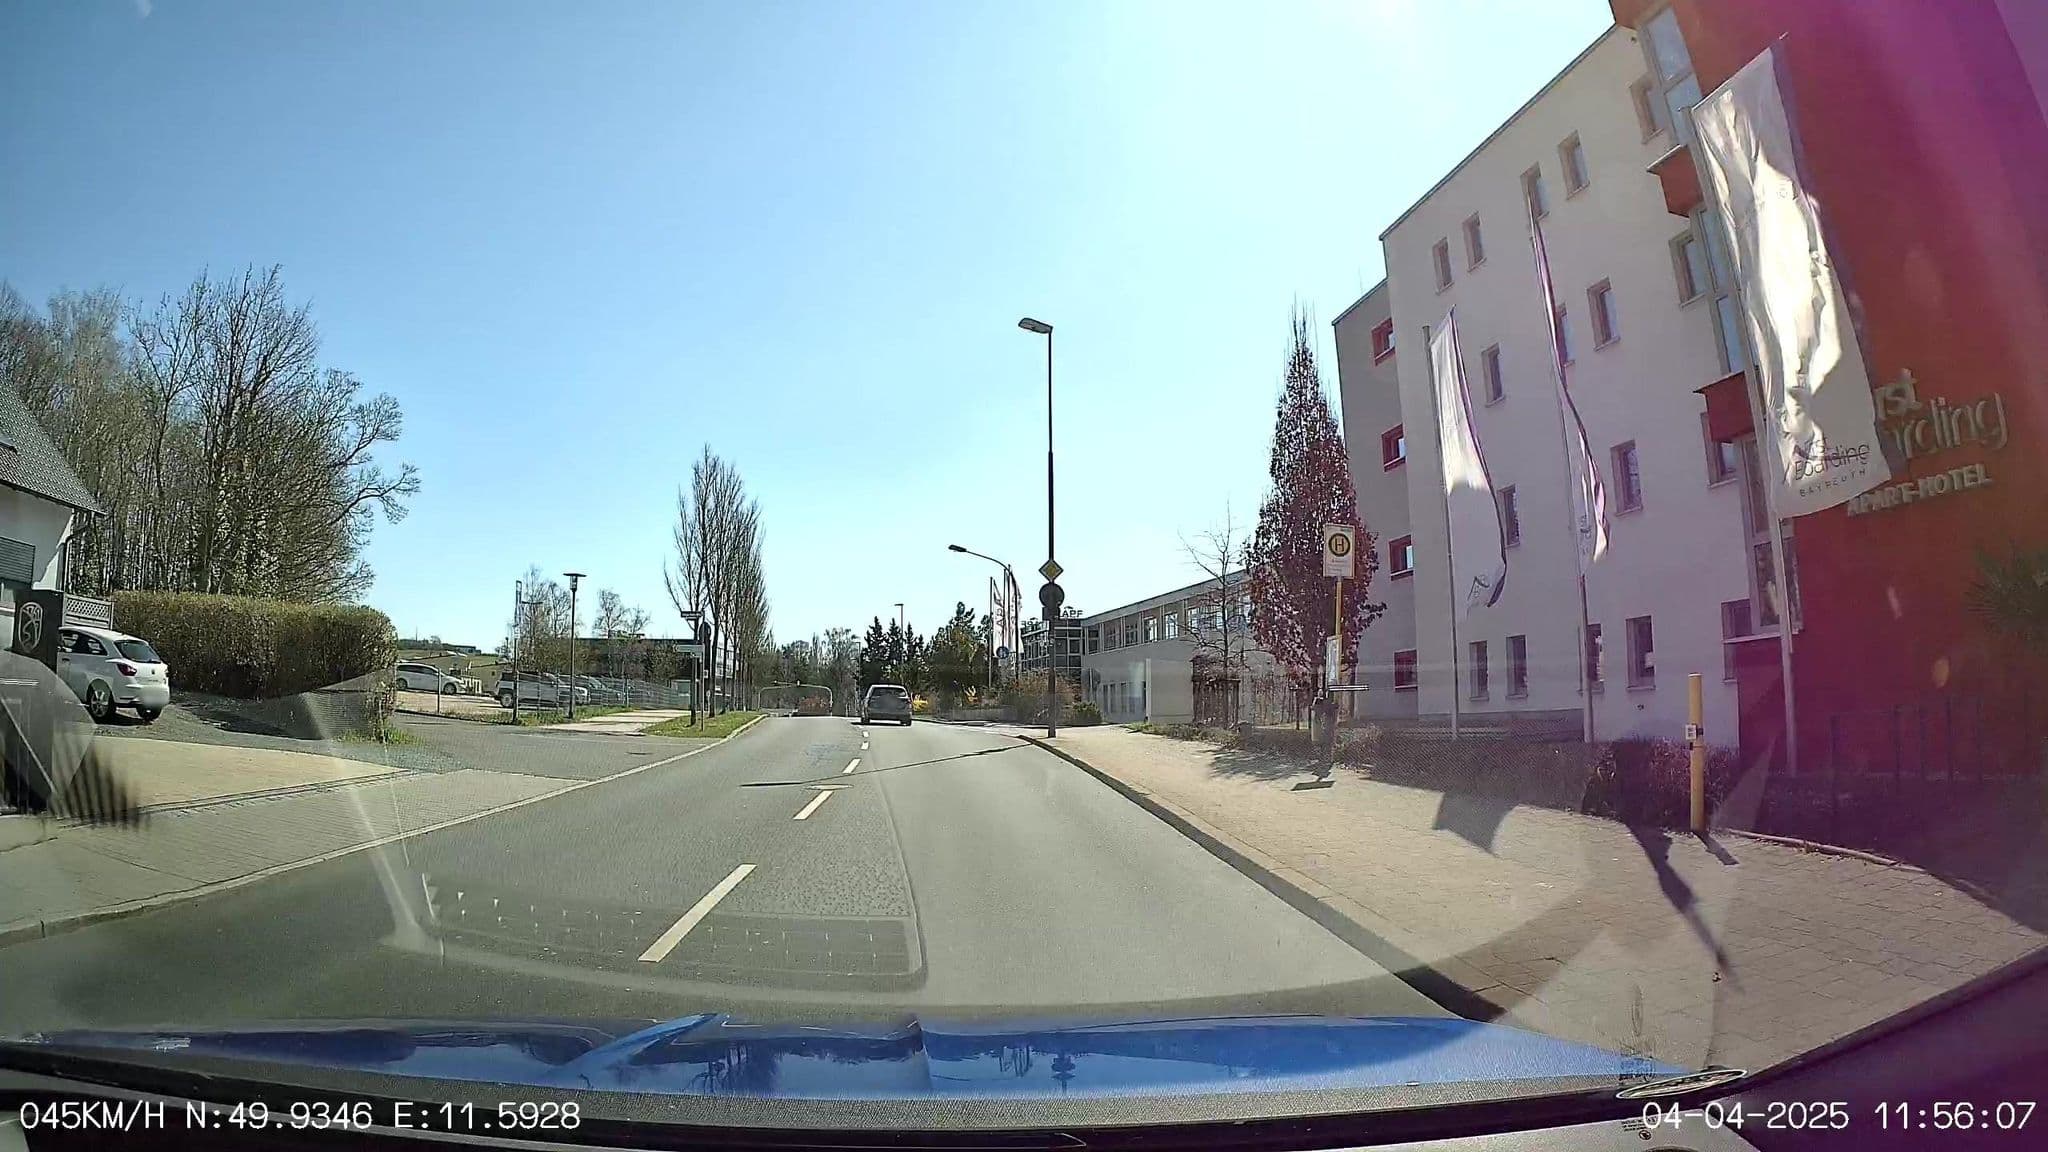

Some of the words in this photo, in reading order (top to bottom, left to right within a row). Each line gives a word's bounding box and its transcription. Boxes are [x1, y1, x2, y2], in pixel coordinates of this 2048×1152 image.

[1896, 392, 2008, 459] rding
[1334, 537, 1345, 552] H
[1061, 609, 1084, 618] APF
